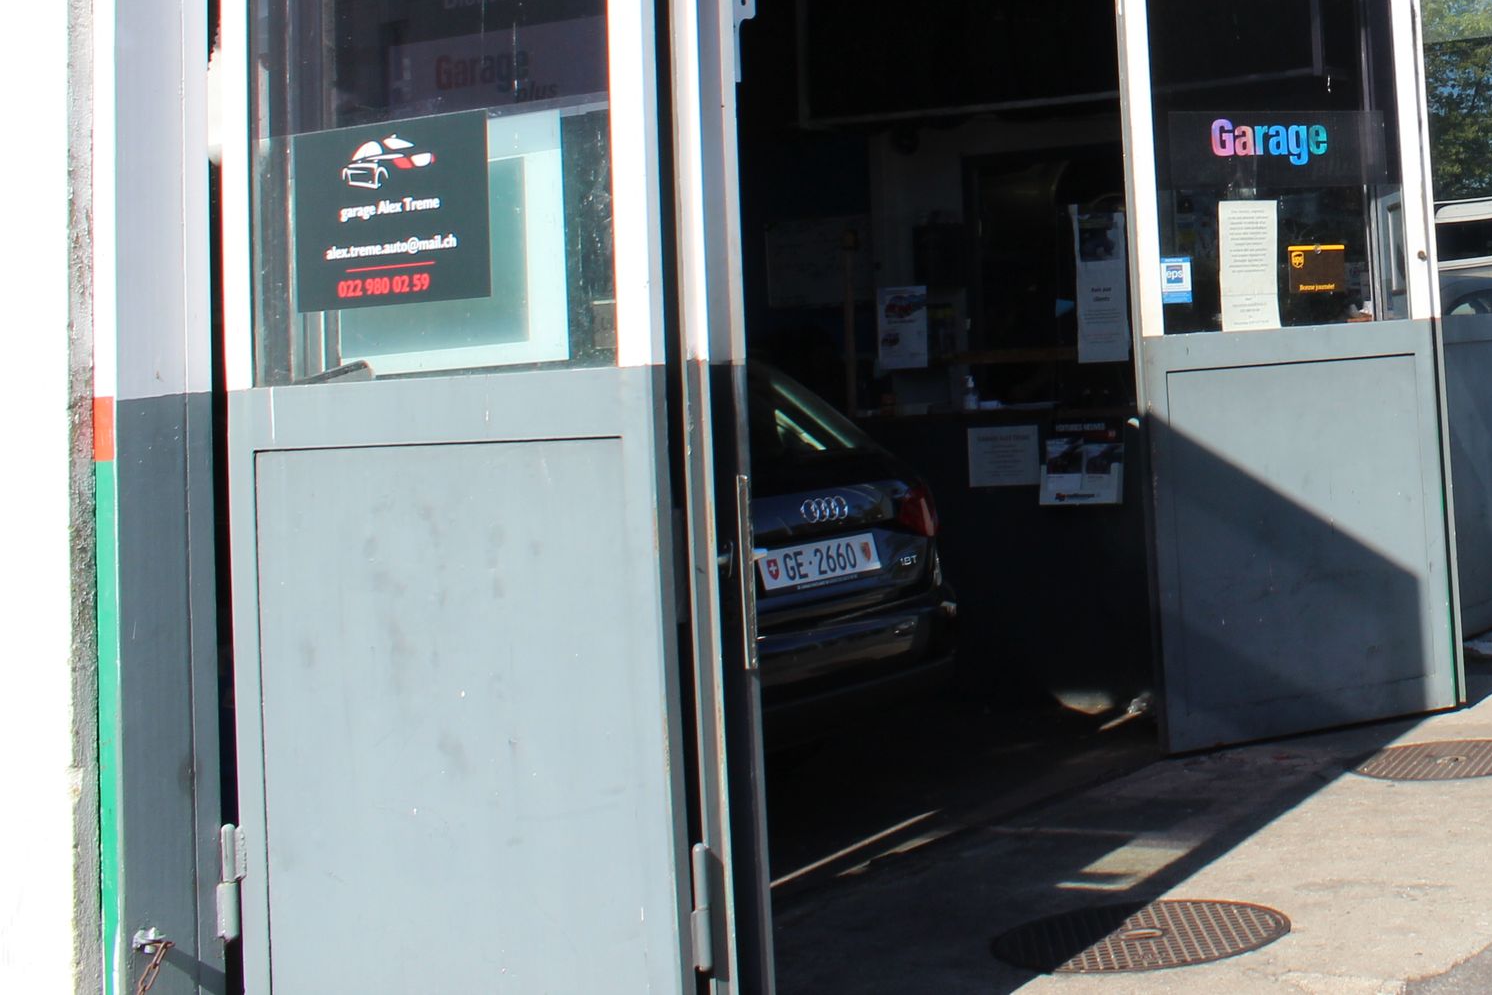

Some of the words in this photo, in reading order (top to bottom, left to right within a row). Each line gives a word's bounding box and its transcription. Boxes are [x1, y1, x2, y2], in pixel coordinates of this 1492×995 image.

[436, 50, 529, 93] Garage
[1211, 118, 1328, 166] Garage
[339, 204, 376, 222] garage
[377, 200, 402, 215] Alex
[403, 196, 440, 212] Treme
[325, 233, 457, 261] alex.treme.auto@mail.ch
[337, 279, 363, 298] 022
[365, 277, 390, 295] 980
[392, 275, 410, 293] 02
[413, 273, 430, 292] 59
